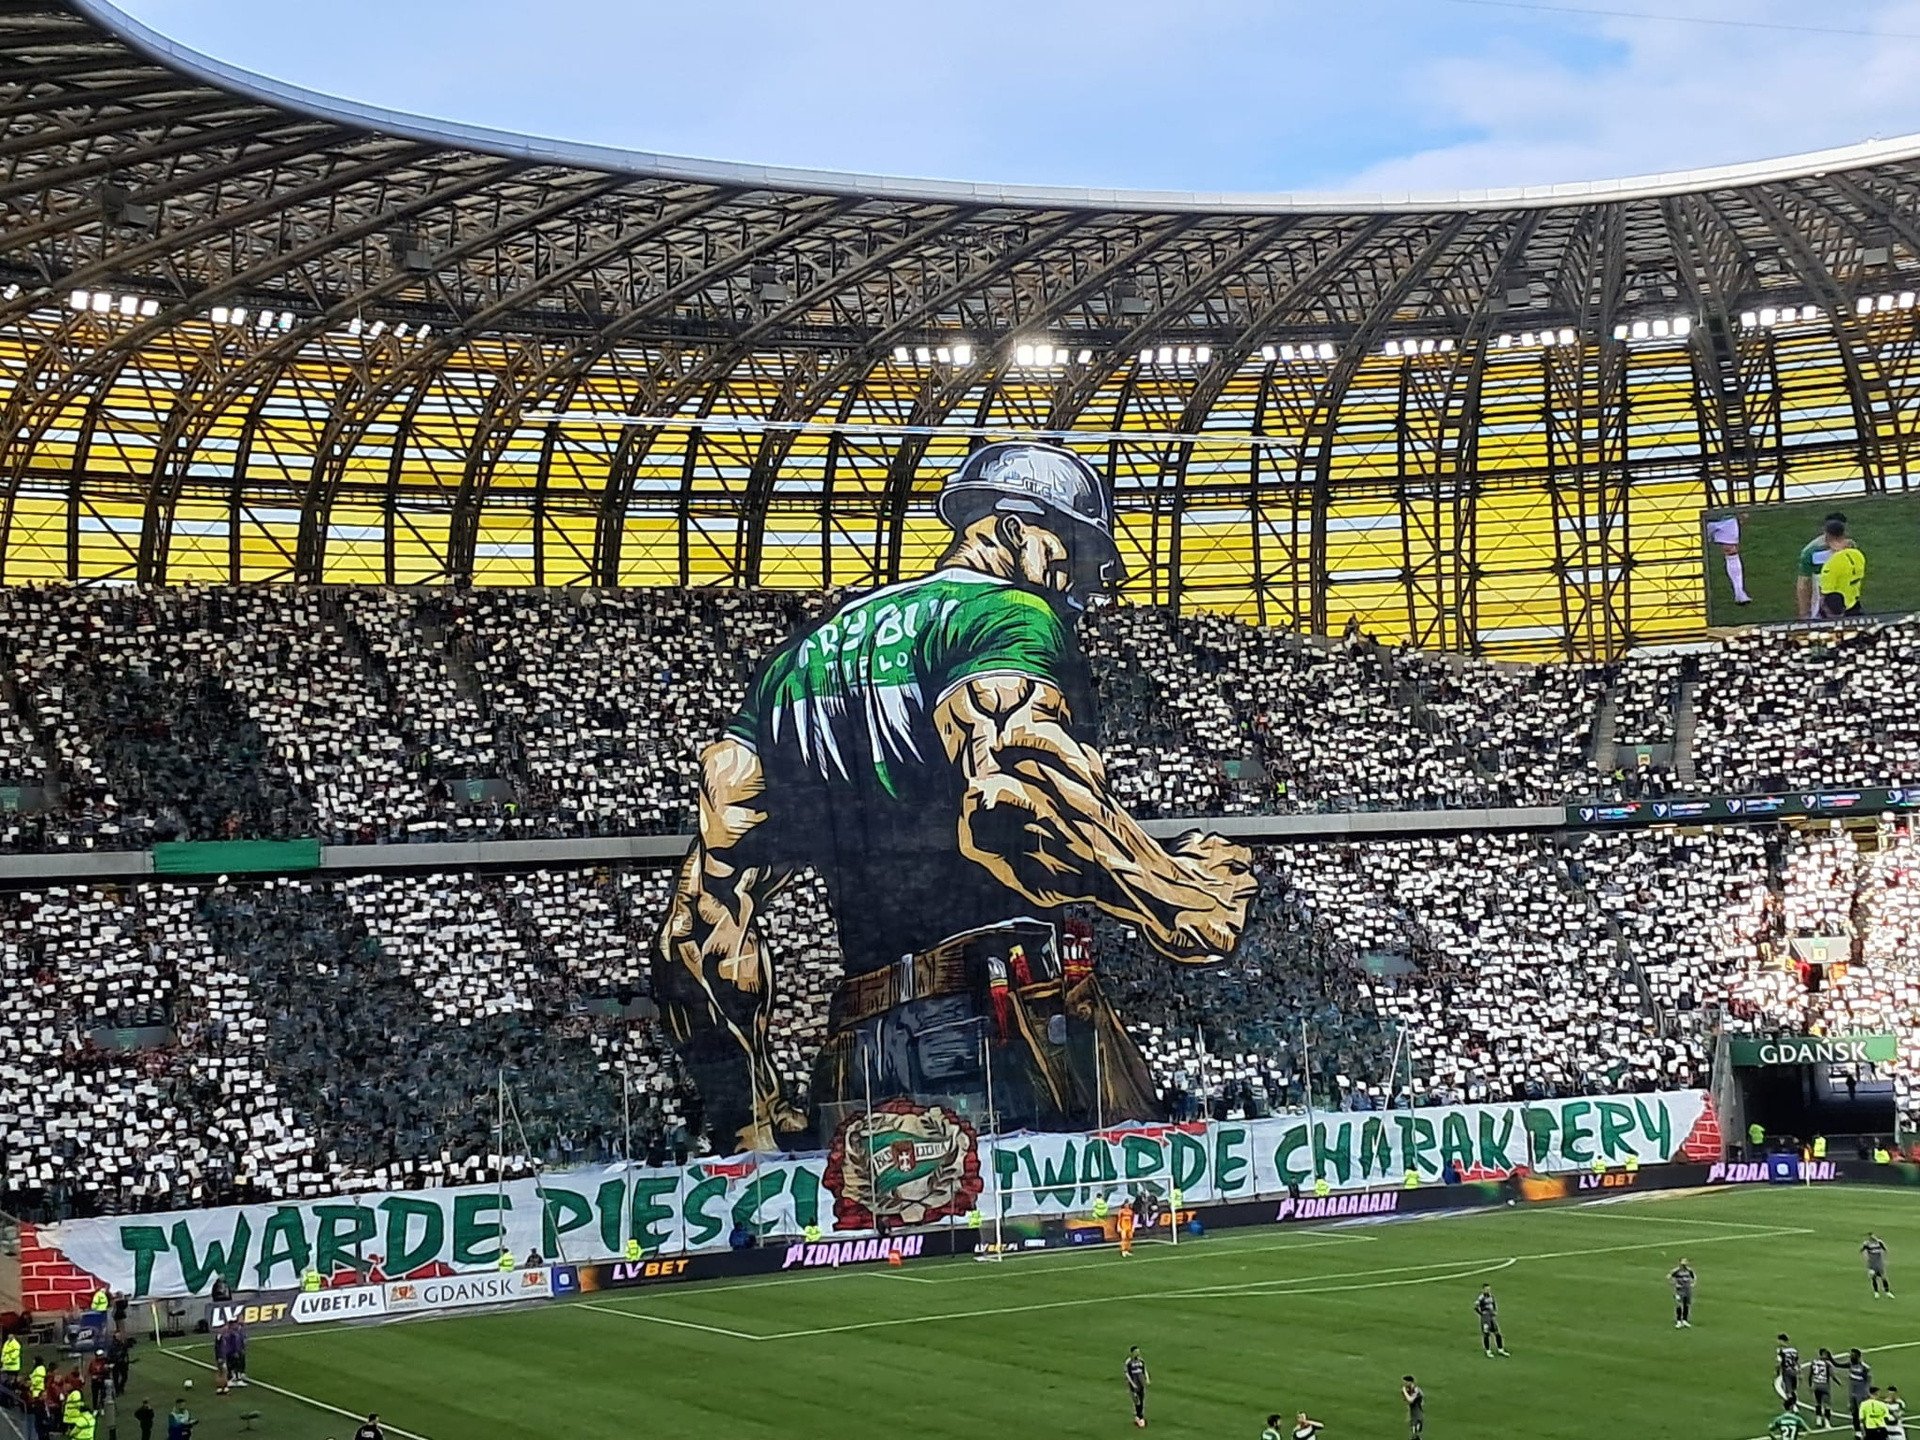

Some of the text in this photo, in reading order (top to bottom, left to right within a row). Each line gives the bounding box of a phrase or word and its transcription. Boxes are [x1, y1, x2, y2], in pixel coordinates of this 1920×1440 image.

[1760, 1038, 1870, 1064] GDAŃSK
[120, 1194, 511, 1297] TWARDE
[994, 1129, 1248, 1212] TWARDE
[1276, 1098, 1671, 1185] CHARAKTERY
[301, 1292, 377, 1314] LVBET.PL
[424, 1278, 513, 1304] GDAŃSK
